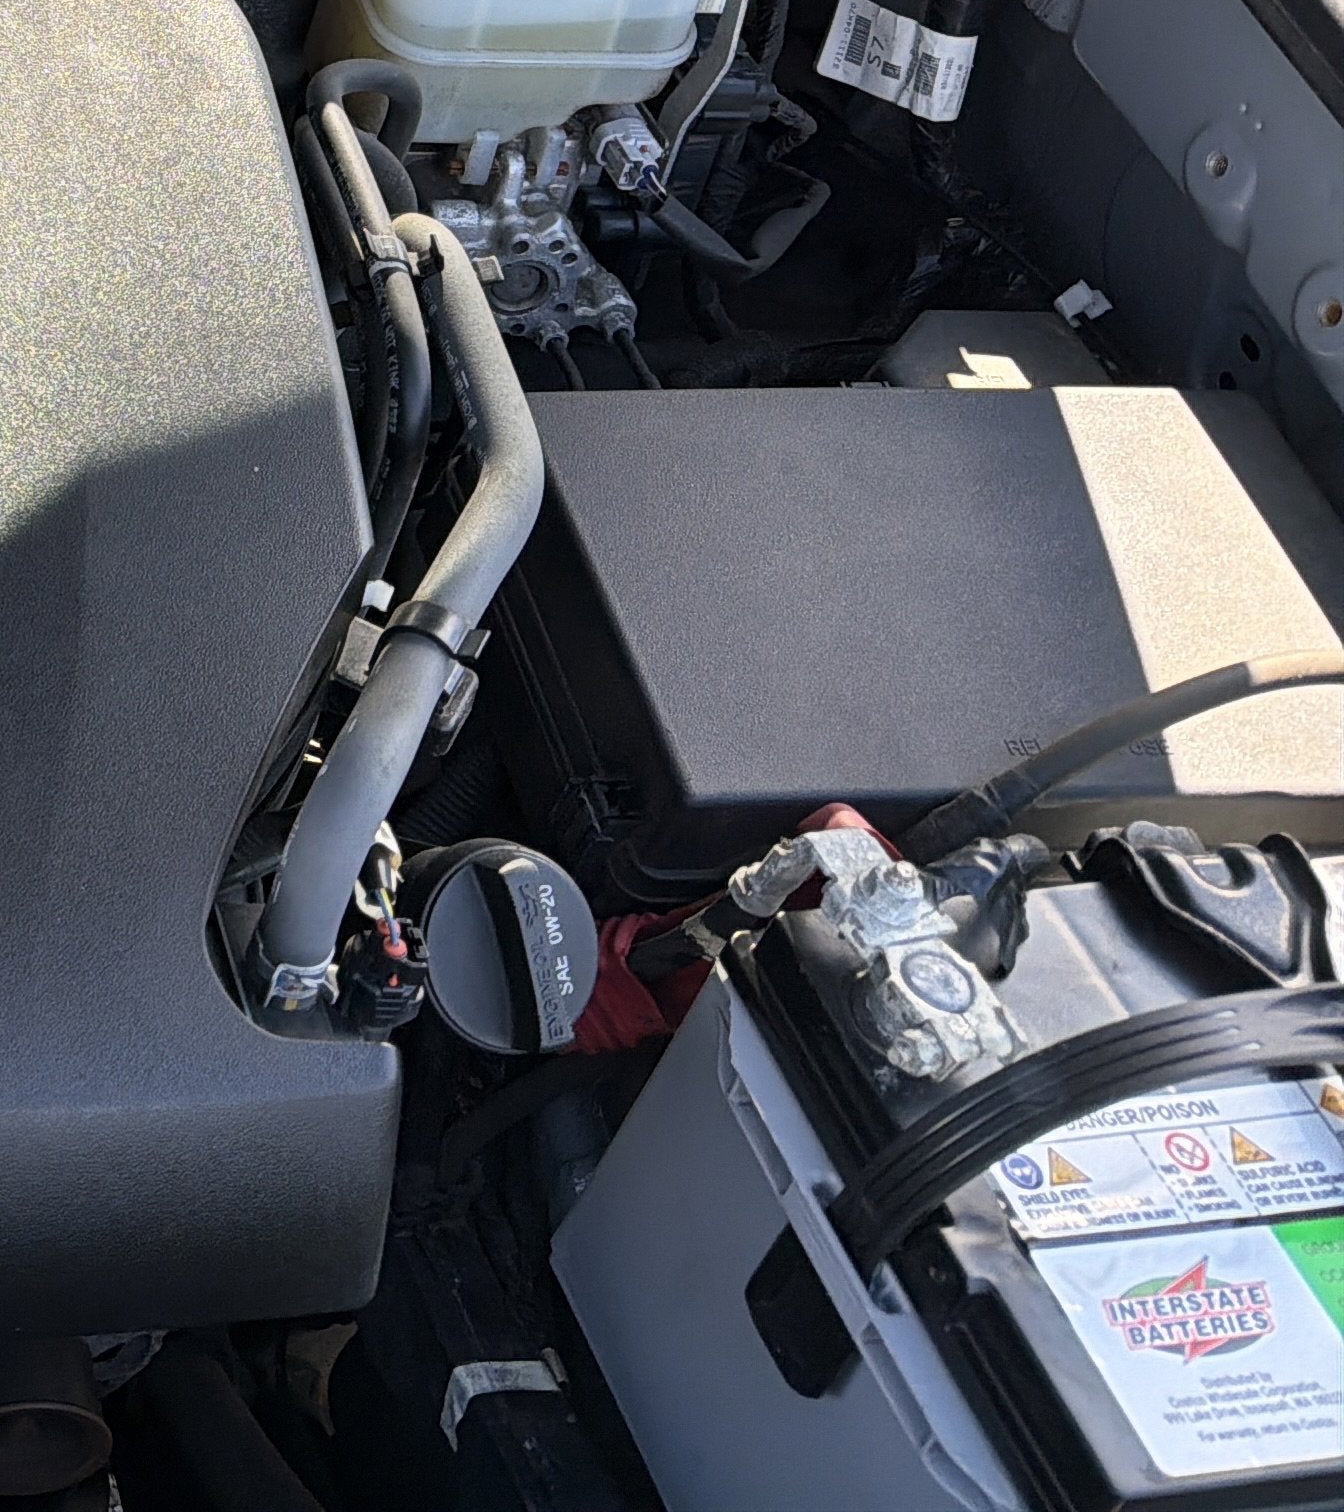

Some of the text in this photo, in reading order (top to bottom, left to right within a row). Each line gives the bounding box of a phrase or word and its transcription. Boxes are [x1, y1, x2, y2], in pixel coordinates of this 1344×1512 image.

[554, 955, 574, 996] SAE
[1109, 1285, 1265, 1322] INTERSTATE
[1128, 1311, 1269, 1345] BATTERIES
